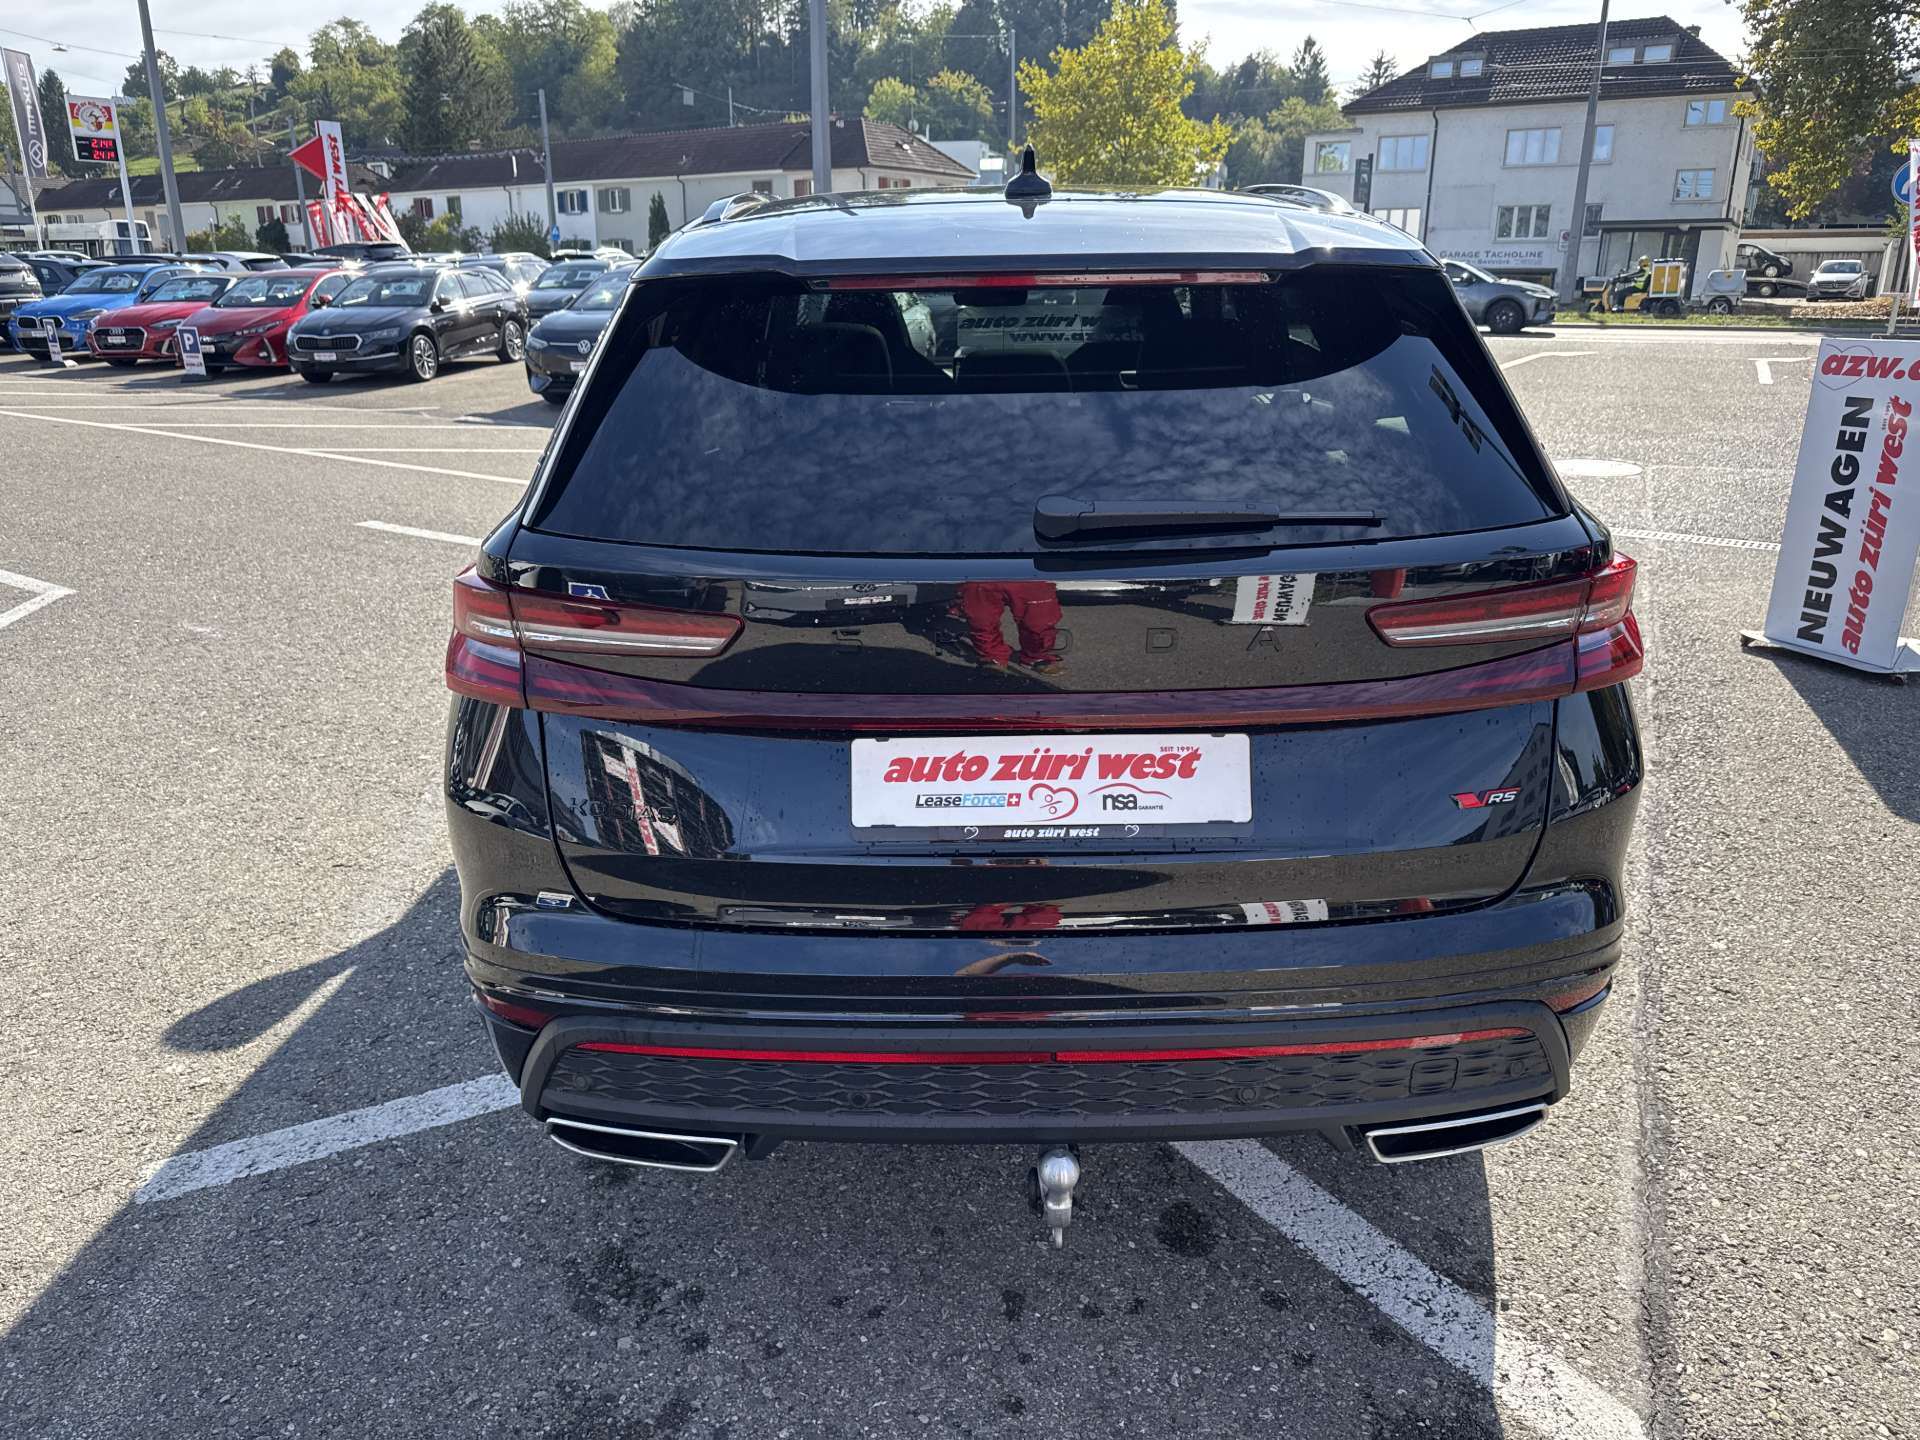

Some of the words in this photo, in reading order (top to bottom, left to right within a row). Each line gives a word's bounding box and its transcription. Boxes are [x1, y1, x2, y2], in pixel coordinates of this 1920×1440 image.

[1485, 250, 1544, 258] TACHOLINE
[958, 314, 1016, 330] auto
[1796, 396, 1875, 644] NEUWAGEN
[1841, 570, 1873, 655] auto
[1859, 486, 1893, 572] züri
[1876, 394, 1912, 485] west
[883, 749, 990, 783] auto
[990, 747, 1093, 781] züri
[1098, 747, 1202, 779] west
[915, 793, 1007, 808] LeaseForce
[1102, 793, 1138, 811] nsa
[1004, 828, 1034, 838] auto
[1036, 827, 1066, 838] züri
[1068, 827, 1100, 837] west
